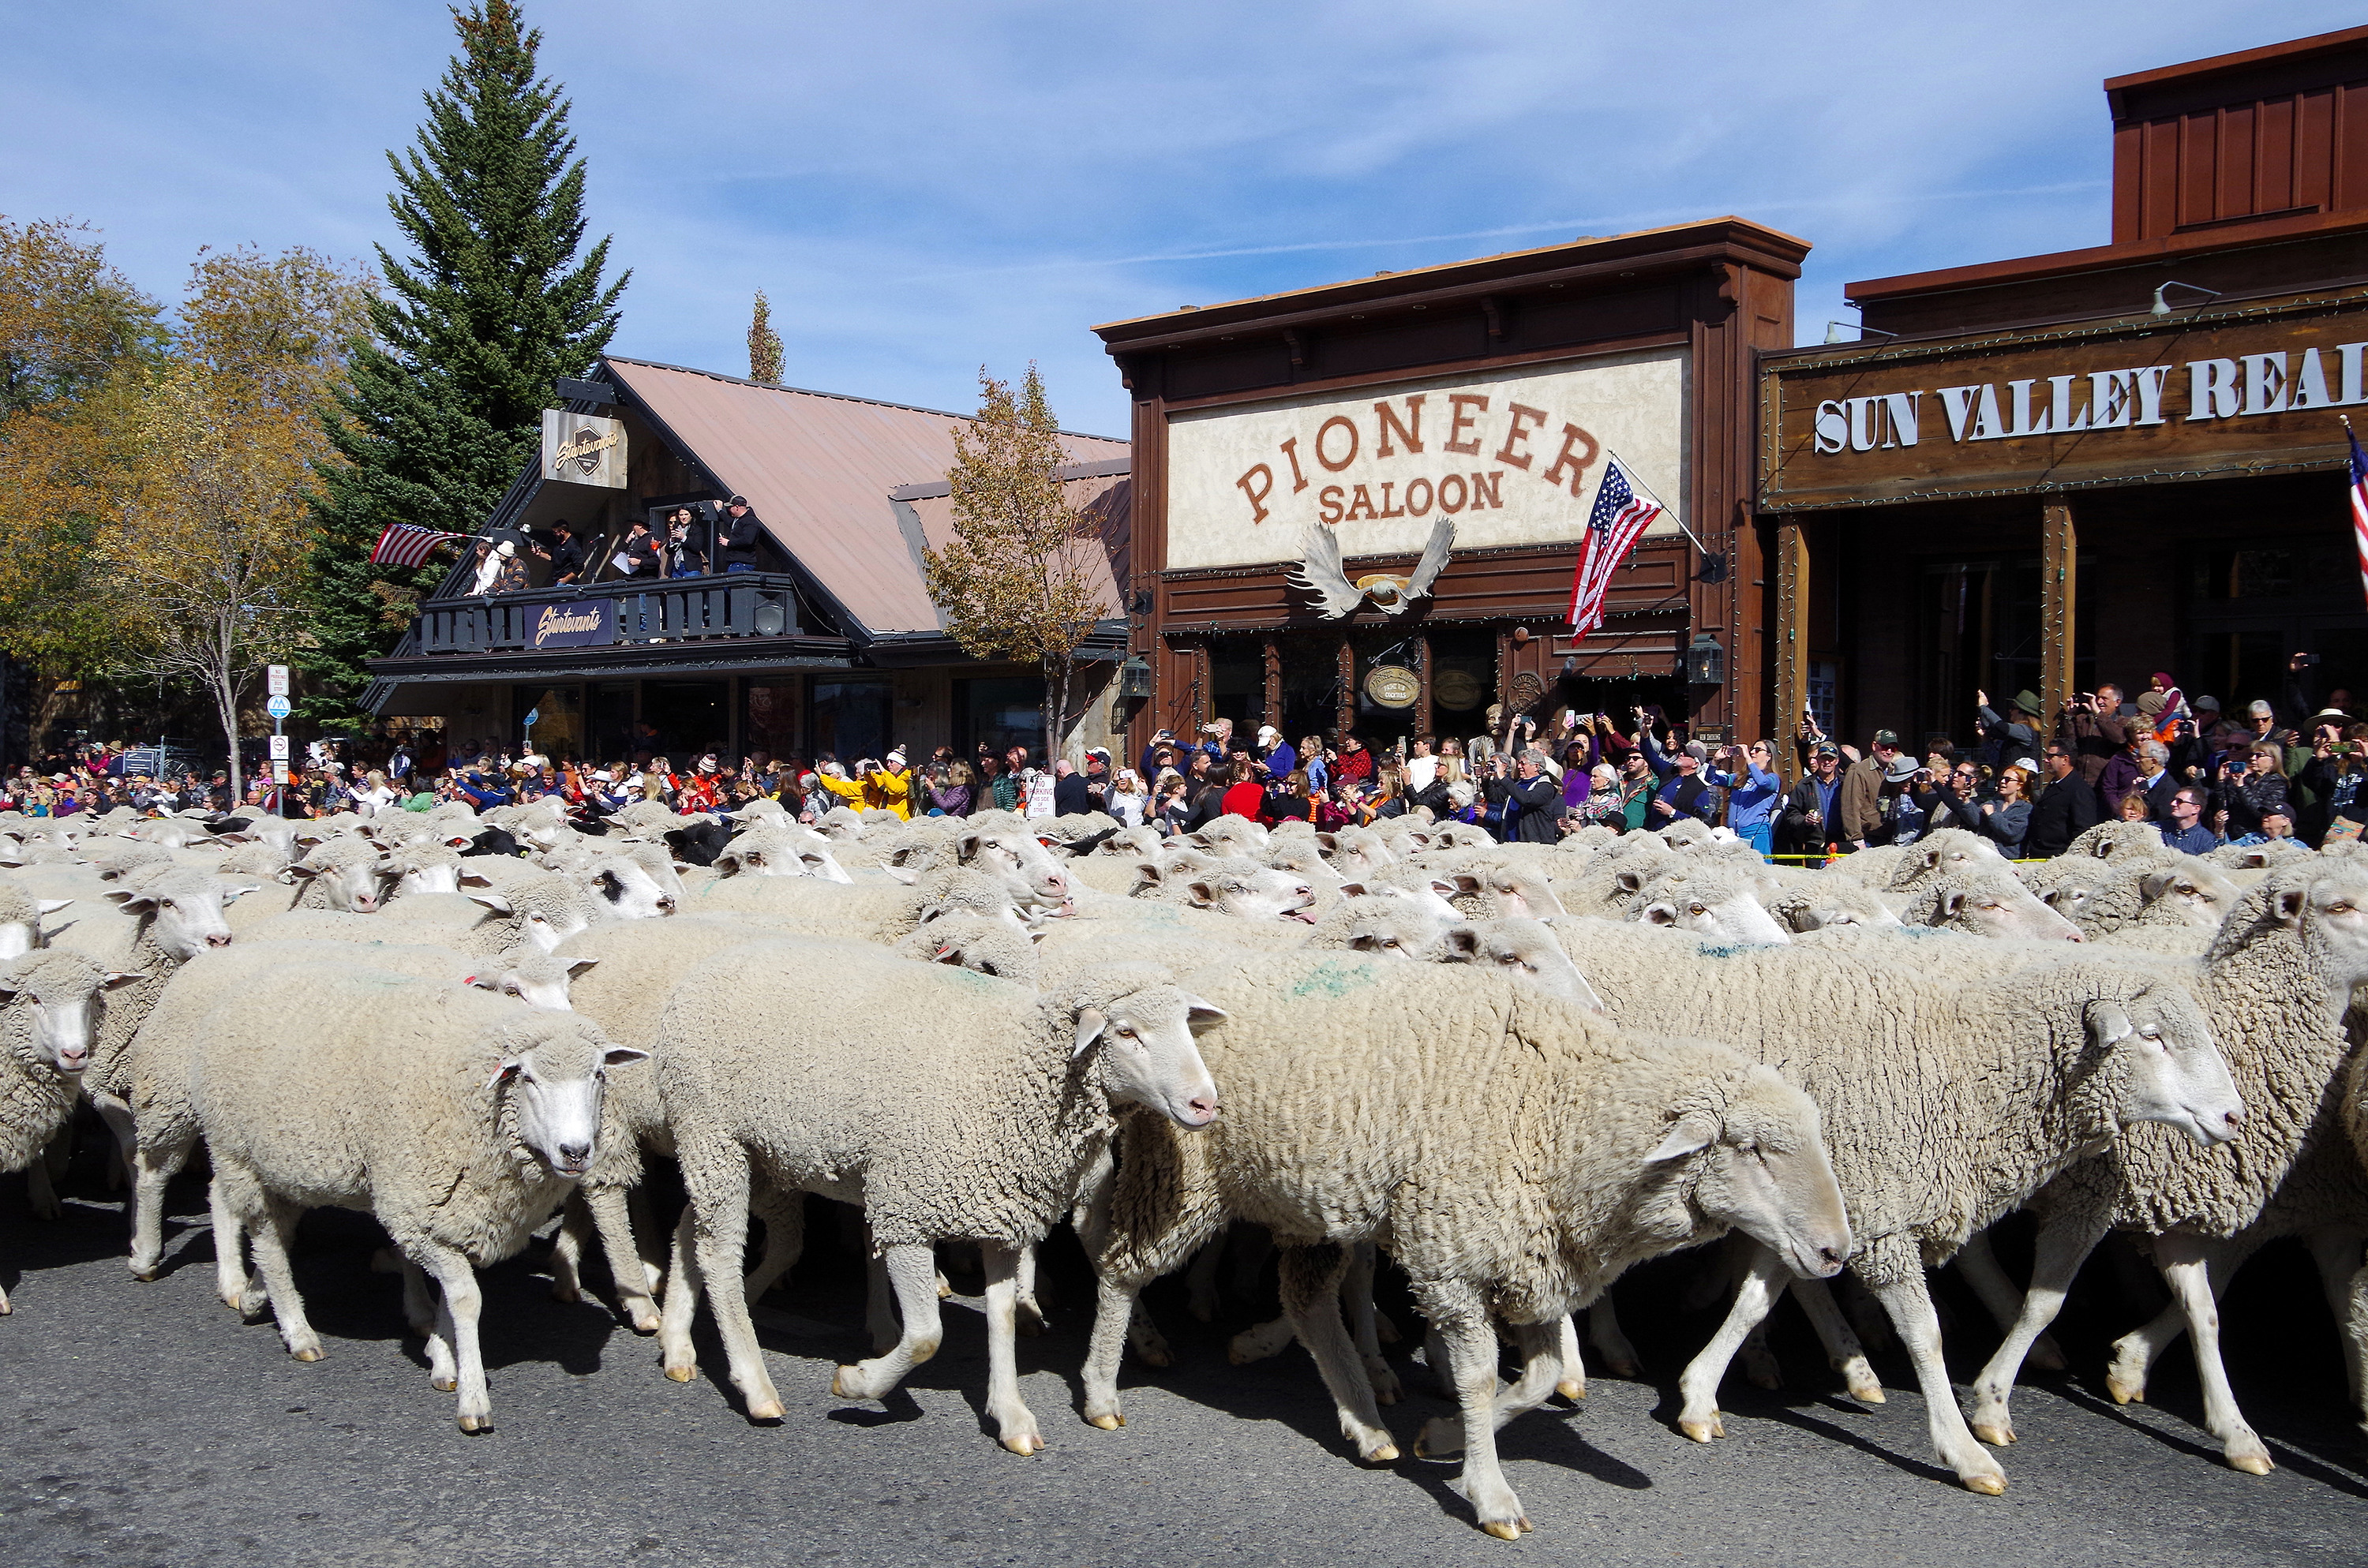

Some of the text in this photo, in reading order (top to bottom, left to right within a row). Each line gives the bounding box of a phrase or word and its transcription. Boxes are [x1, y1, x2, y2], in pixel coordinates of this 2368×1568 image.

[1815, 342, 2368, 455] SUN VALLEY REAL
[556, 431, 619, 471] Sturtevants
[1235, 393, 1600, 525] PIONEER
[1319, 471, 1504, 524] SALOON
[535, 606, 602, 646] Sturtevants
